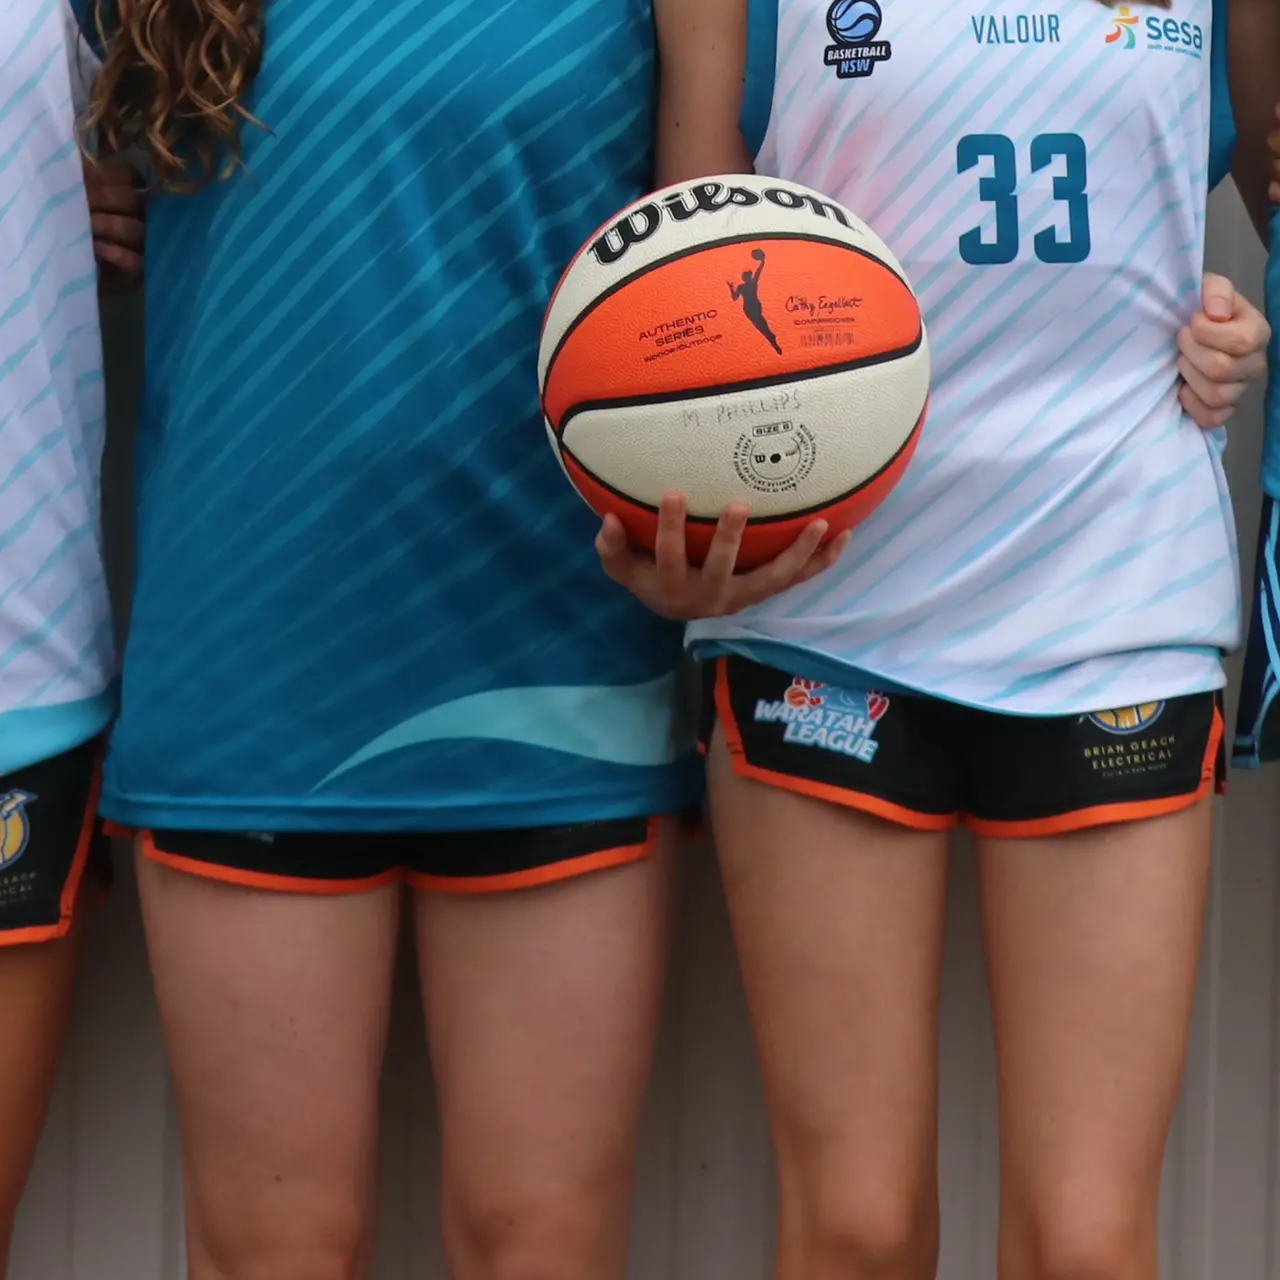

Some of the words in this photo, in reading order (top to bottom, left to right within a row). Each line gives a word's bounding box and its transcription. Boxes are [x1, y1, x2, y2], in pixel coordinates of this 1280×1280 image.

[972, 14, 1060, 45] VALOUR
[1146, 16, 1202, 50] sesa
[827, 45, 887, 61] BASKETBALL
[840, 58, 871, 75] NSW
[956, 132, 1091, 265] 33
[587, 182, 856, 266] Wilson
[639, 310, 718, 341] AUTHENTIC
[655, 325, 704, 347] SERIES
[756, 425, 779, 435] SIZE
[754, 698, 878, 738] WARATAH
[783, 722, 879, 764] LEAGUE
[1084, 744, 1125, 758] BRIAN
[1092, 749, 1172, 770] ELECTRICAL
